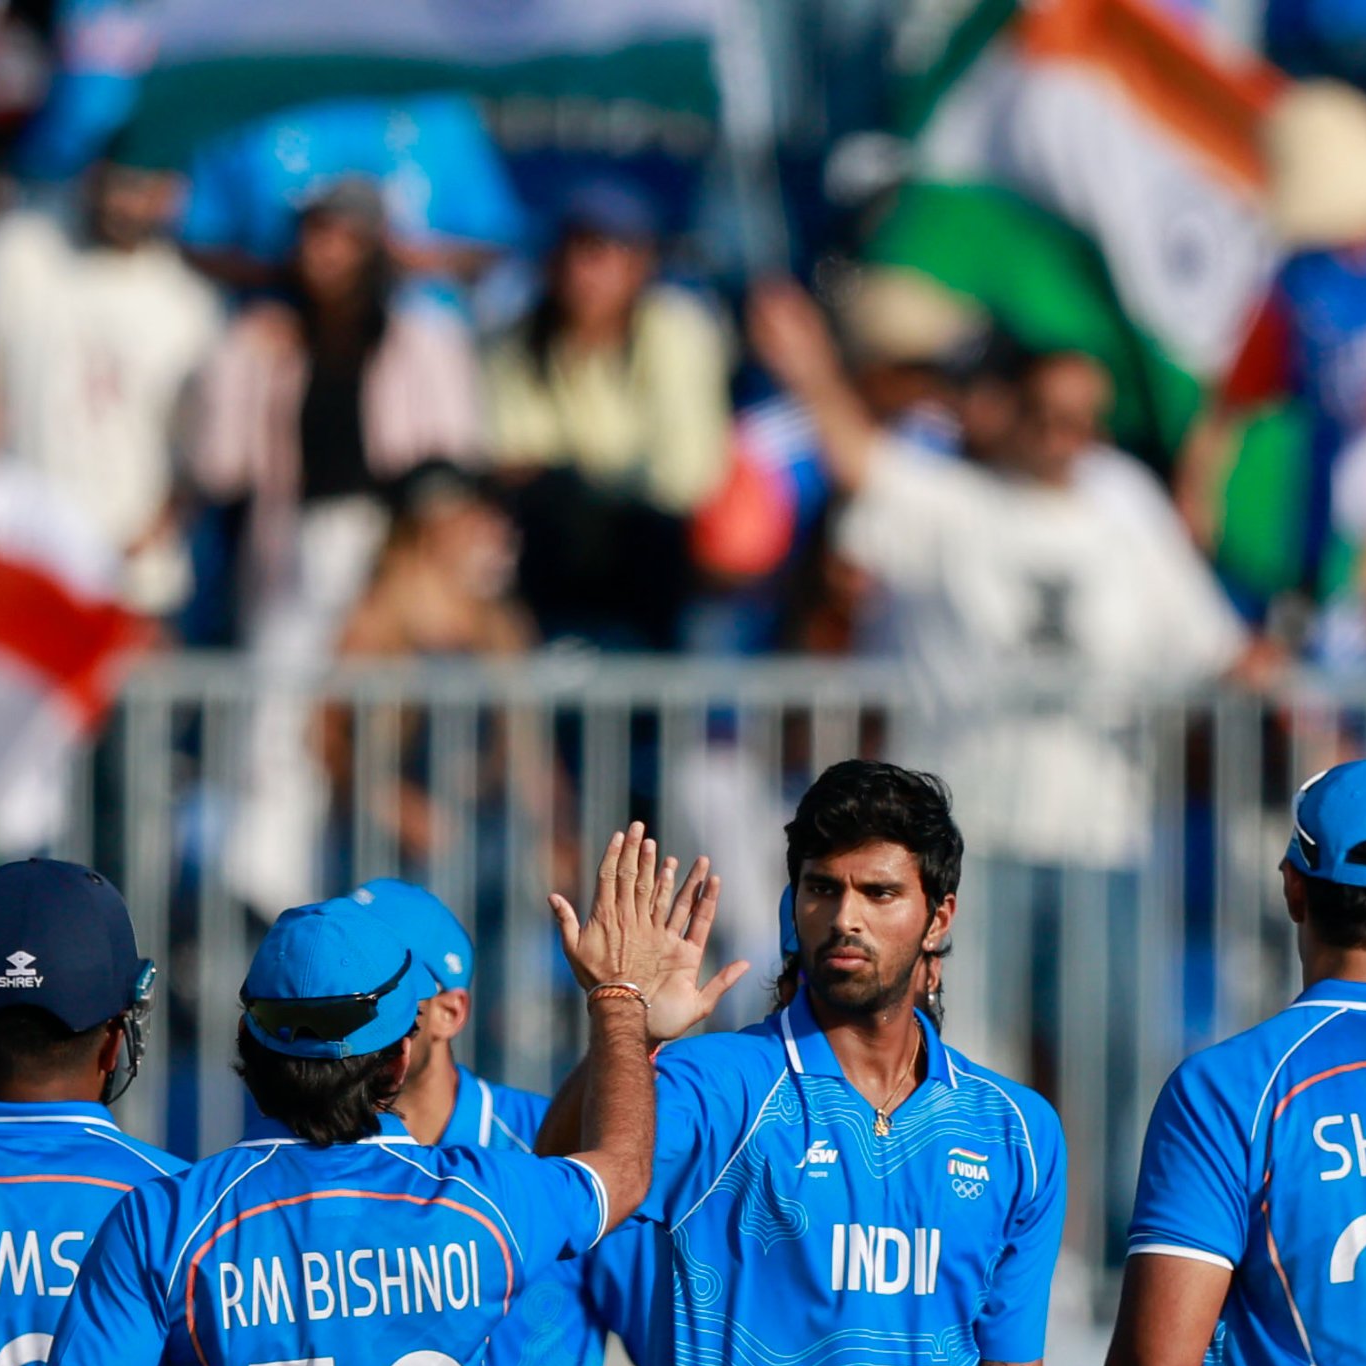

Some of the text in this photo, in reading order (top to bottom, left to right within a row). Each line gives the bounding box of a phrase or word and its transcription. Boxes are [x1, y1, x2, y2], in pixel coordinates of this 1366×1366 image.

[947, 1159, 990, 1181] INDIA
[219, 1239, 481, 1330] RM BISHNOI
